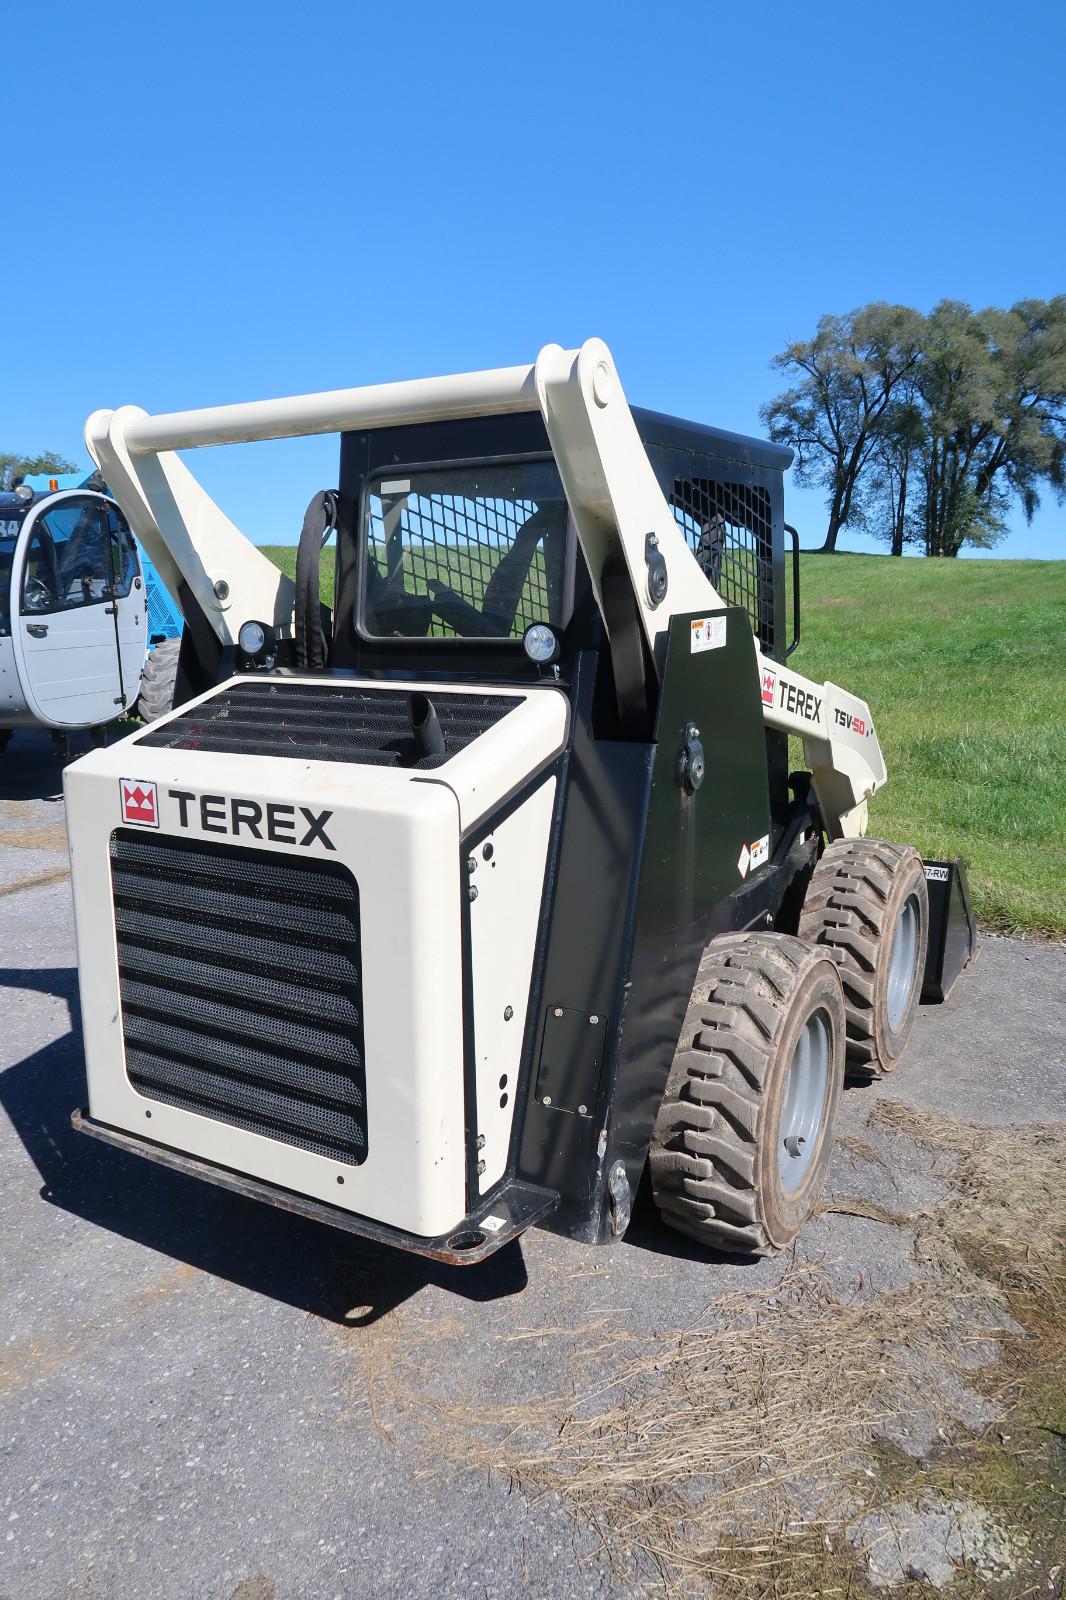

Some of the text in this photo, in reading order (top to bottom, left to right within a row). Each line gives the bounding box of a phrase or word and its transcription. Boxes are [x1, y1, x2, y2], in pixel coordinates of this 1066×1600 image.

[779, 679, 822, 723] TEREX
[834, 707, 865, 736] TSV-50
[168, 789, 338, 852] TEREX
